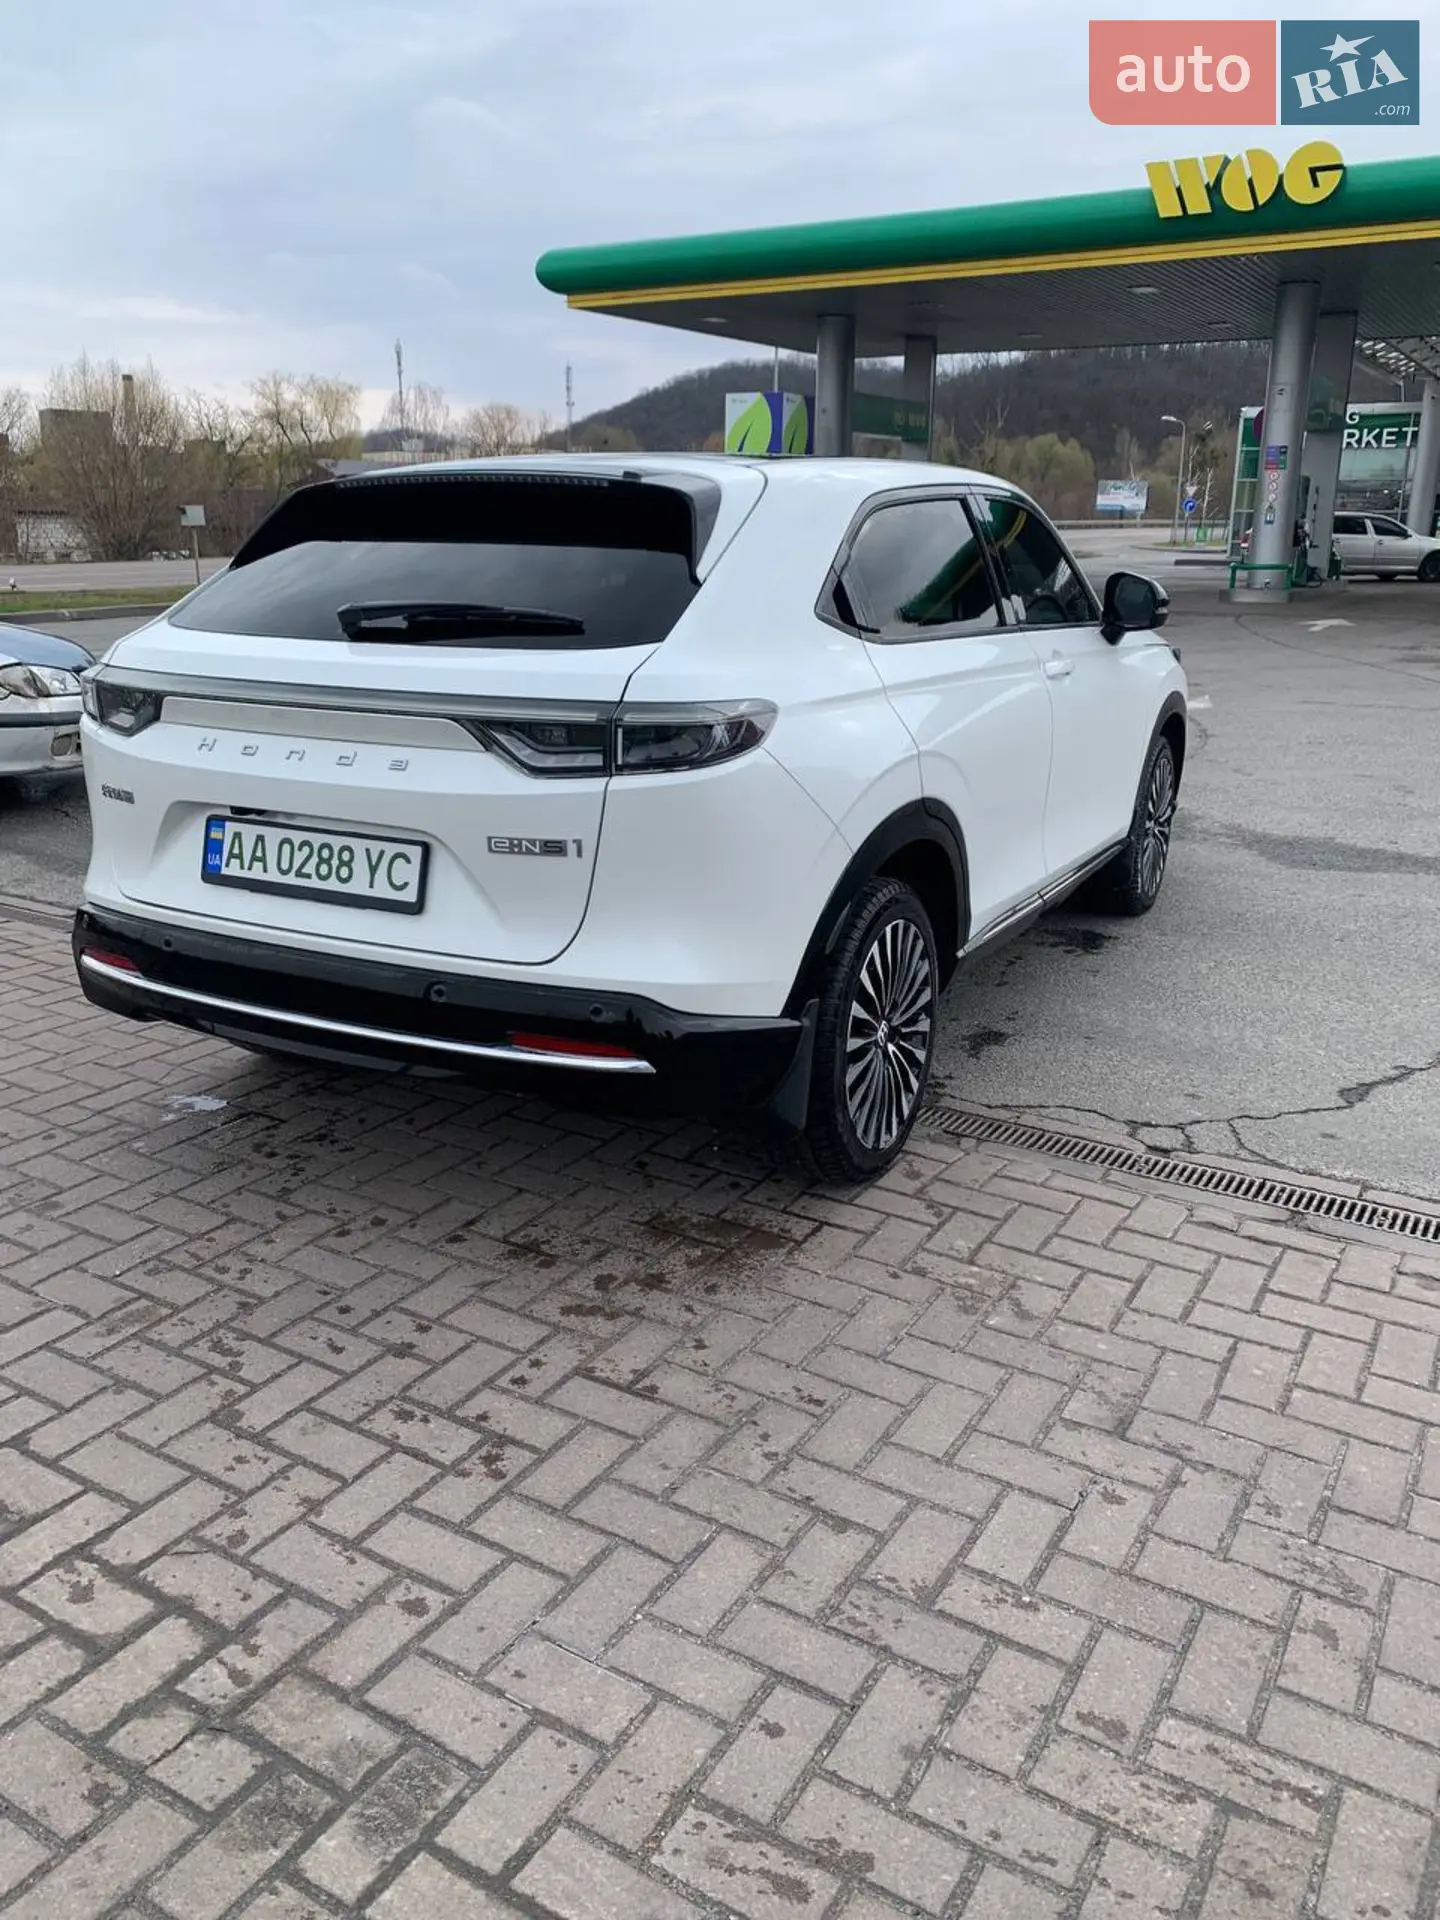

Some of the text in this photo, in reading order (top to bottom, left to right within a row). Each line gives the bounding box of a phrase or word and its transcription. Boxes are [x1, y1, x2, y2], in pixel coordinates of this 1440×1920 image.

[1144, 139, 1347, 219] WOG
[1342, 427, 1419, 448] RKET
[207, 853, 222, 866] UA
[224, 830, 413, 892] AA 0288 YC
